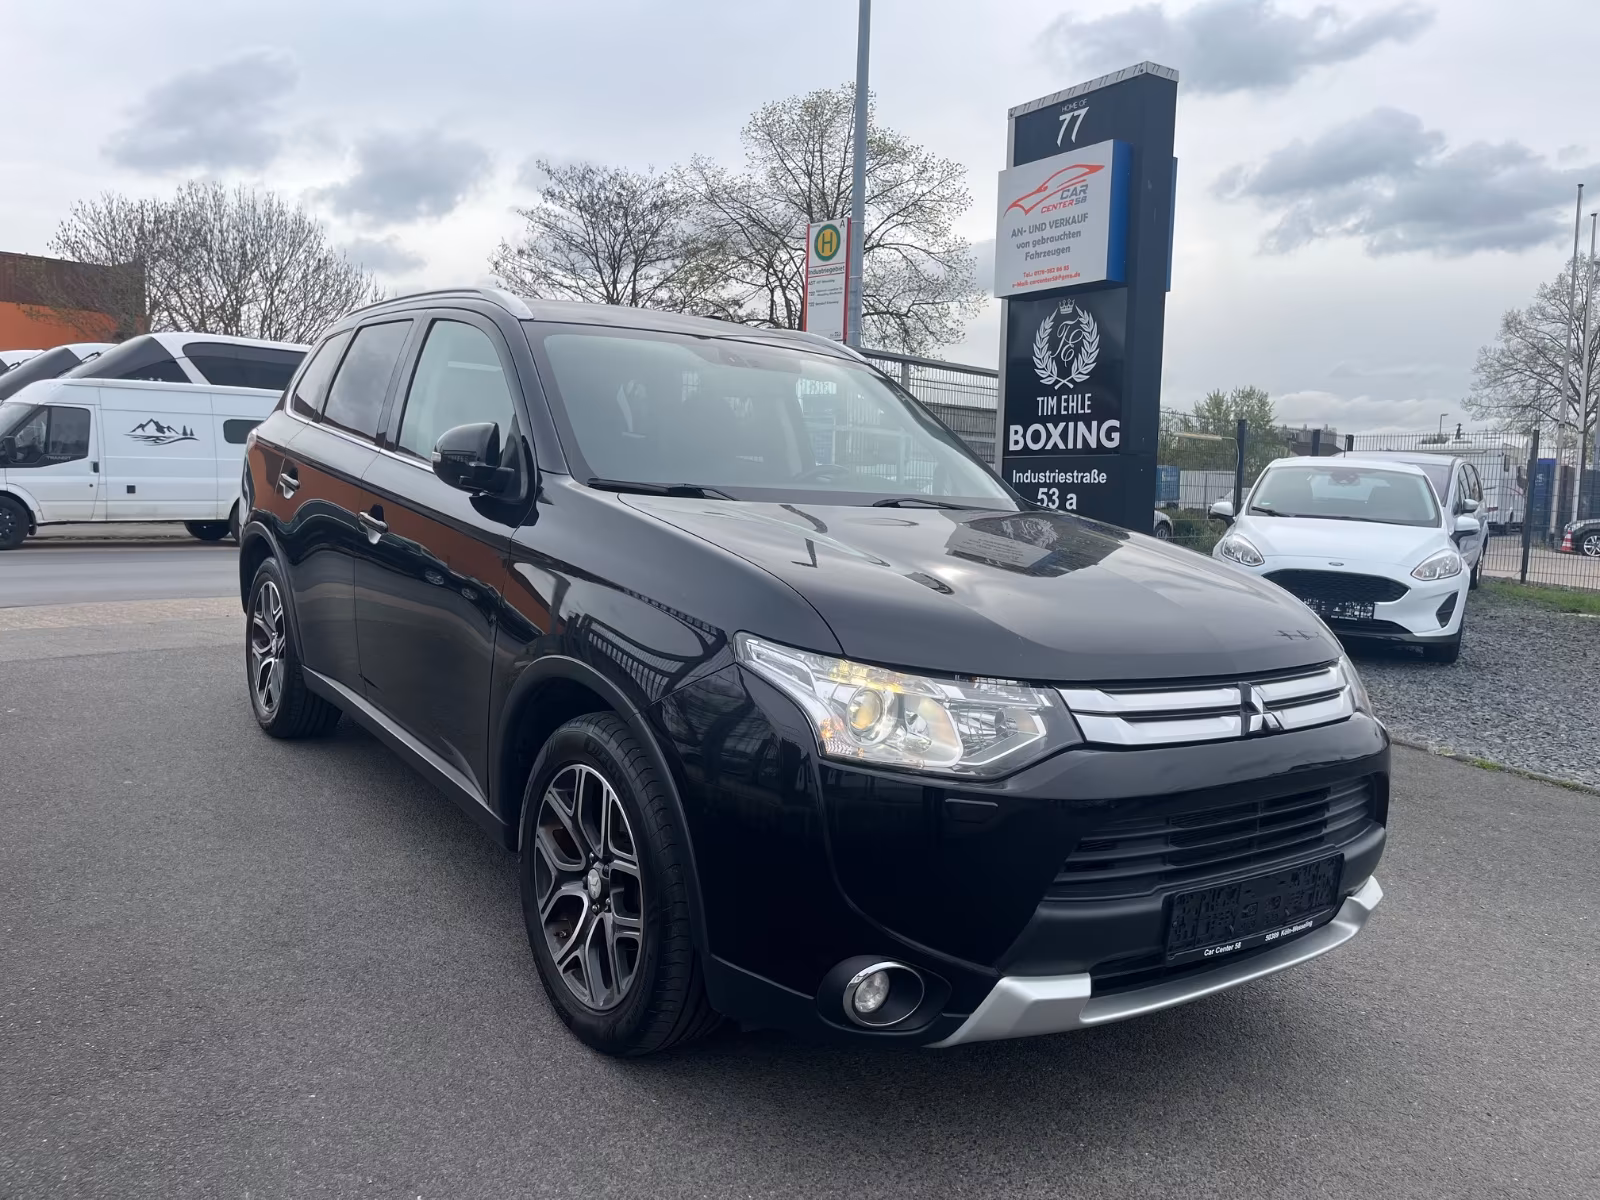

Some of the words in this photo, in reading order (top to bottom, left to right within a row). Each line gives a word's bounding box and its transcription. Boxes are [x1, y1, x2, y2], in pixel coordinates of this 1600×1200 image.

[1151, 64, 1161, 72] 77
[1166, 68, 1175, 77] 77
[1023, 102, 1032, 113] 77
[1037, 97, 1046, 107] 77
[1052, 92, 1061, 102] 77
[1067, 87, 1076, 97] 77
[1083, 81, 1092, 92] 77
[1099, 75, 1109, 86] 77
[1116, 69, 1126, 81] 77
[1061, 101, 1078, 113] HOME
[1078, 98, 1088, 108] OF
[1056, 106, 1090, 148] 77
[1060, 184, 1089, 200] CAR
[839, 219, 846, 228] A
[1011, 227, 1027, 239] AN-
[1028, 222, 1047, 235] UND
[1049, 212, 1089, 230] VERKAUF
[821, 231, 833, 254] H
[1016, 240, 1030, 250] von
[1032, 230, 1082, 248] gebrauchten
[1024, 245, 1071, 262] Fahrzeugen
[808, 264, 845, 275] Industriegebiet
[1036, 395, 1057, 416] TIM
[1060, 393, 1092, 415] EHLE
[1008, 419, 1121, 451] BOXING
[1012, 468, 1107, 484] Industriestraße
[1036, 487, 1060, 510] 53
[1065, 492, 1077, 510] a
[1204, 948, 1215, 957] Car
[1215, 944, 1234, 954] Center
[1234, 941, 1242, 950] 58
